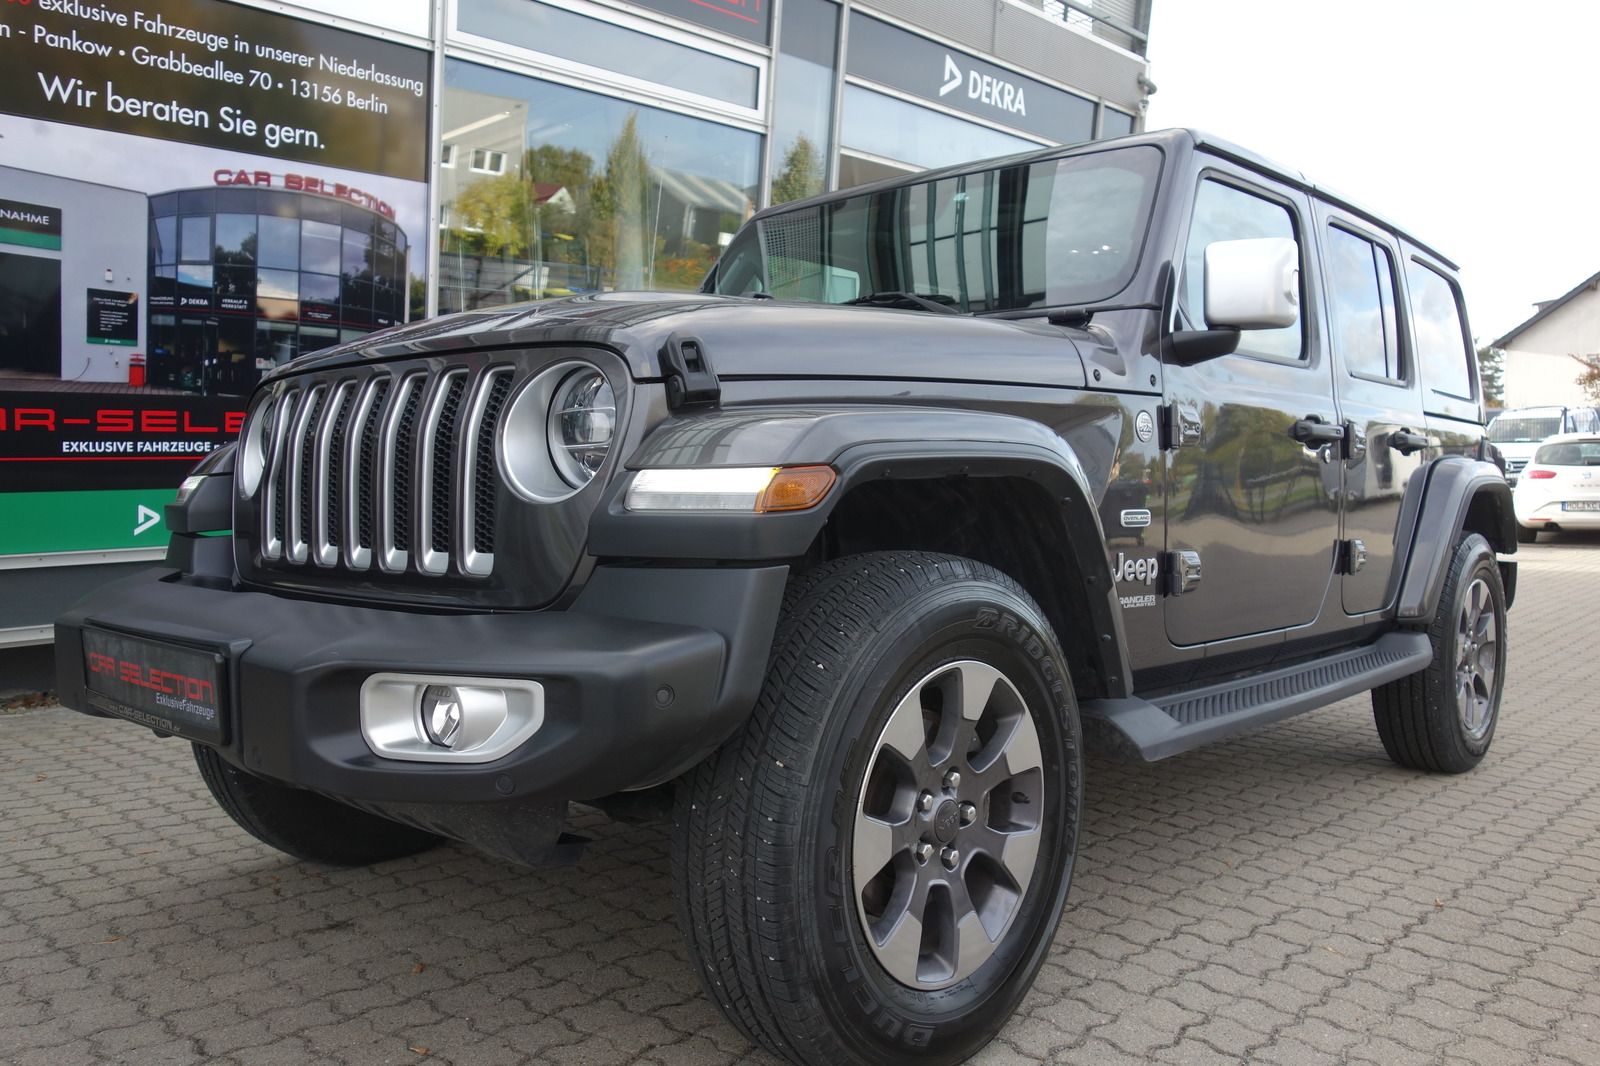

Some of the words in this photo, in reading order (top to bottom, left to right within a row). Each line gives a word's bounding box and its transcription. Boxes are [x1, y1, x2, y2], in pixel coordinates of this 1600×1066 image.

[34, 24, 113, 57] Pankow
[132, 45, 244, 85] Grabbeallee
[249, 69, 272, 91] 70
[290, 78, 342, 105] 13156
[347, 90, 388, 115] Berlin
[39, 0, 128, 26] exklusive
[133, 10, 229, 52] Fahrzeuge
[234, 34, 249, 54] in
[255, 42, 315, 68] unserer
[319, 53, 424, 97] Niederlassung
[37, 71, 98, 108] Wir
[106, 80, 210, 128] beraten
[218, 105, 257, 137] Sie
[264, 122, 326, 150] gern.
[967, 70, 1026, 117] DEKRA
[213, 169, 271, 188] CAR
[284, 173, 397, 221] SELECTION
[62, 441, 134, 453] EXKLUSIVE
[137, 441, 212, 453] FAHRZEUGE
[1113, 552, 1159, 586] Jeep
[88, 651, 117, 678] CAR
[119, 660, 215, 704] SELECTION
